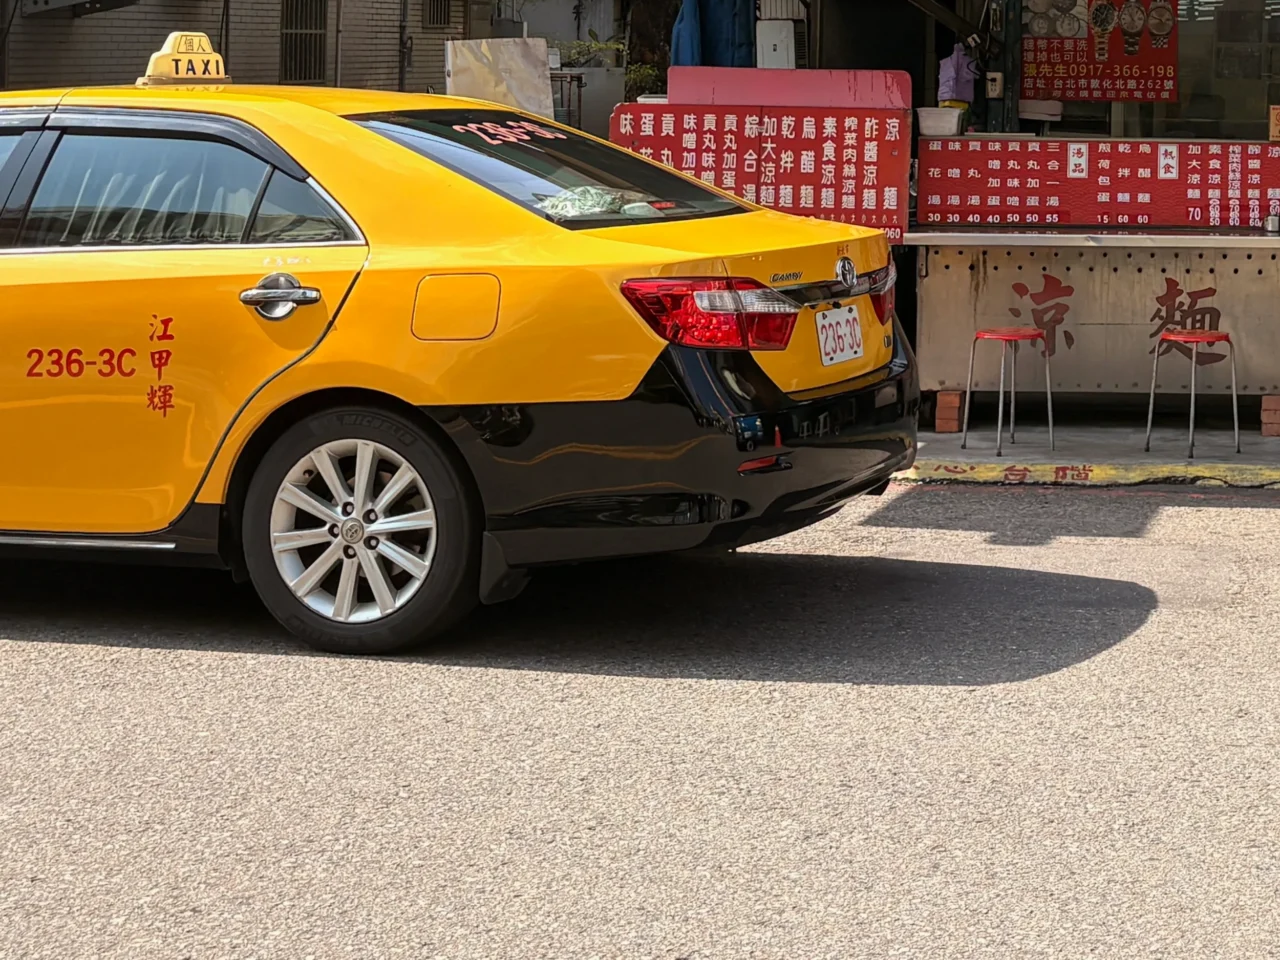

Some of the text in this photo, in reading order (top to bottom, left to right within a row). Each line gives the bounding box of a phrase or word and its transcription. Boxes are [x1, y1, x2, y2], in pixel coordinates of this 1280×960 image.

[184, 36, 206, 52] 個人
[171, 58, 220, 75] TAXI
[760, 115, 778, 207] 加大涼麵
[778, 116, 796, 208] 乾拌麵
[820, 116, 838, 209] 素食涼麵
[883, 118, 901, 210] 涼麵
[1071, 146, 1085, 174] 湯品
[927, 213, 941, 222] 30
[947, 213, 960, 222] 30
[967, 214, 980, 222] 40
[986, 214, 1000, 223] 40
[1006, 214, 1020, 222] 50
[1025, 214, 1039, 222] 50
[1045, 214, 1059, 223] 55
[1097, 214, 1110, 224] 15
[1117, 214, 1129, 224] 60
[1137, 214, 1149, 224] 60
[1187, 207, 1201, 221] 70
[26, 348, 137, 378] 236-3C
[146, 313, 175, 419] 江甲輝
[913, 464, 1094, 481] 心台階
